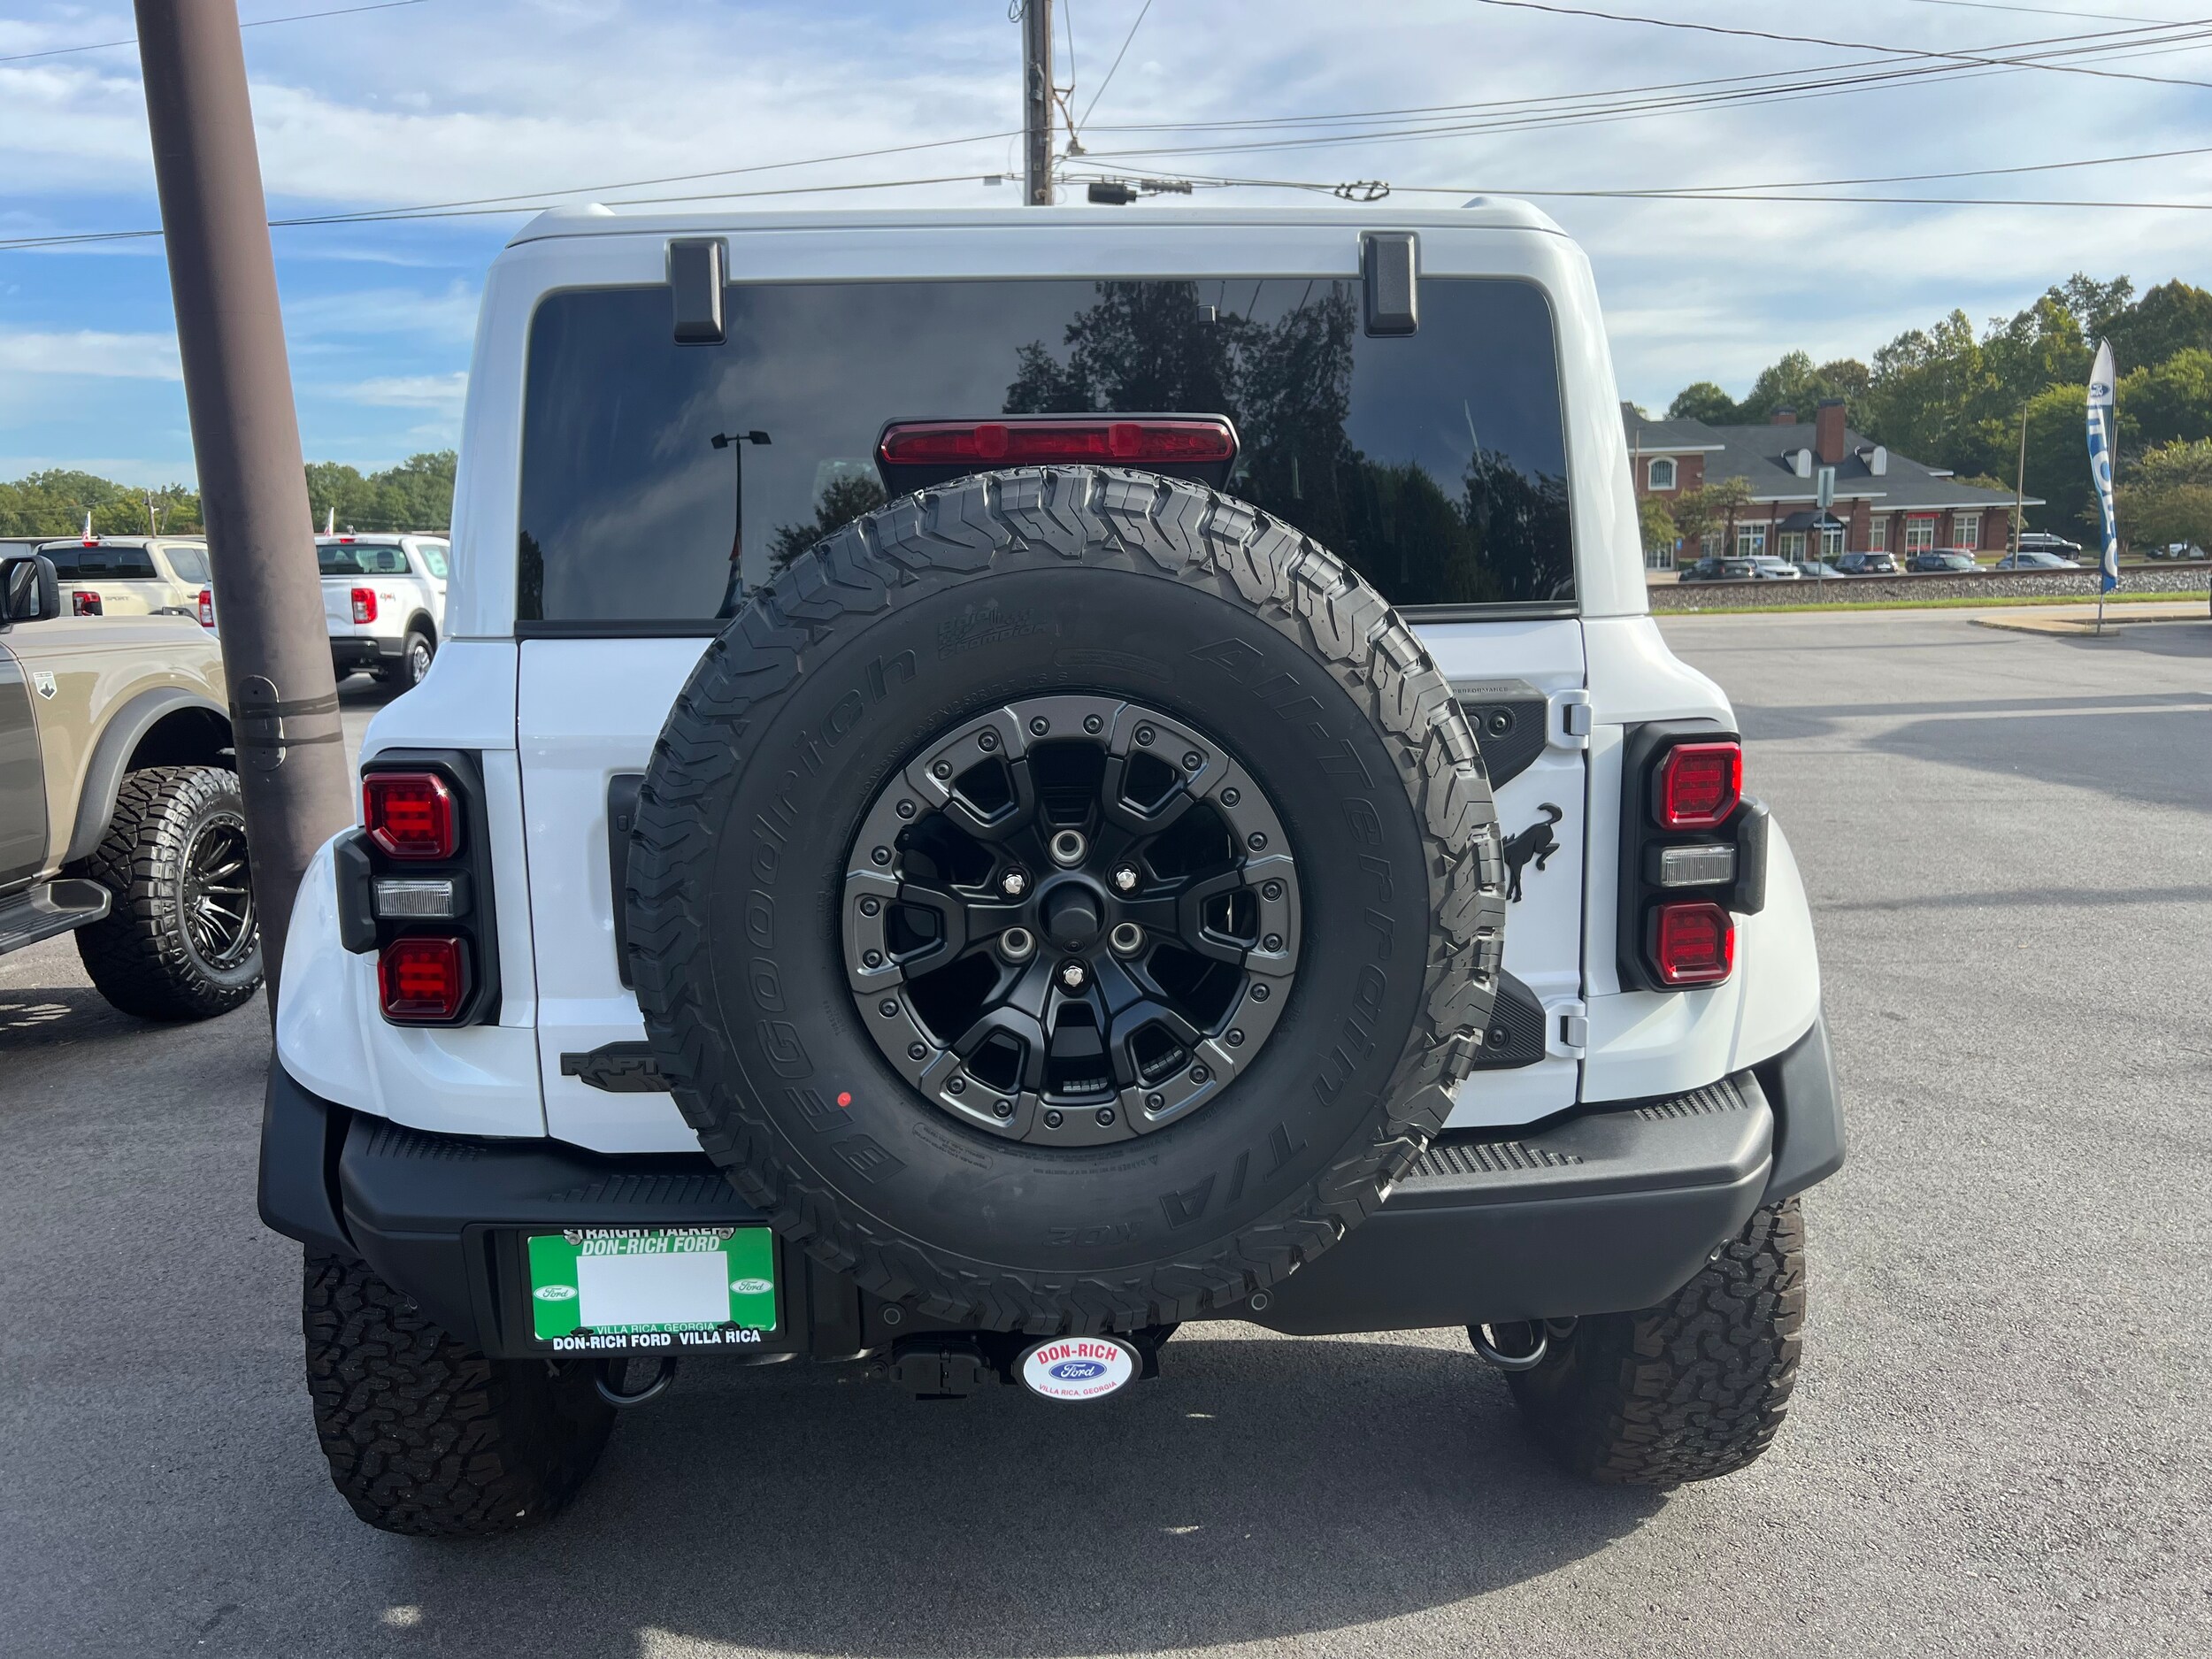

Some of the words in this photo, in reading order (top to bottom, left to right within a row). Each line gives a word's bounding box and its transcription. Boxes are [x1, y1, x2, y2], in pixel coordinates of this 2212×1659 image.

[1186, 637, 1395, 1107] All-Terrain
[745, 648, 918, 1185] BFGoodrich
[564, 1056, 657, 1079] RAPT
[581, 1237, 668, 1256] DON-RICH
[673, 1236, 720, 1252] FORD
[541, 1287, 569, 1299] Ford
[739, 1280, 764, 1292] Ford
[596, 1325, 628, 1335] VILLA
[664, 1322, 715, 1333] GEORGIA
[553, 1334, 626, 1350] DON-RICH
[631, 1333, 671, 1348] FORD
[679, 1330, 721, 1345] VILLA
[726, 1329, 761, 1343] RICA
[1036, 1343, 1118, 1365] DON-RICH
[1060, 1363, 1095, 1378] Ford
[1039, 1383, 1059, 1395] VILLA
[1083, 1381, 1118, 1395] GEORGIA
